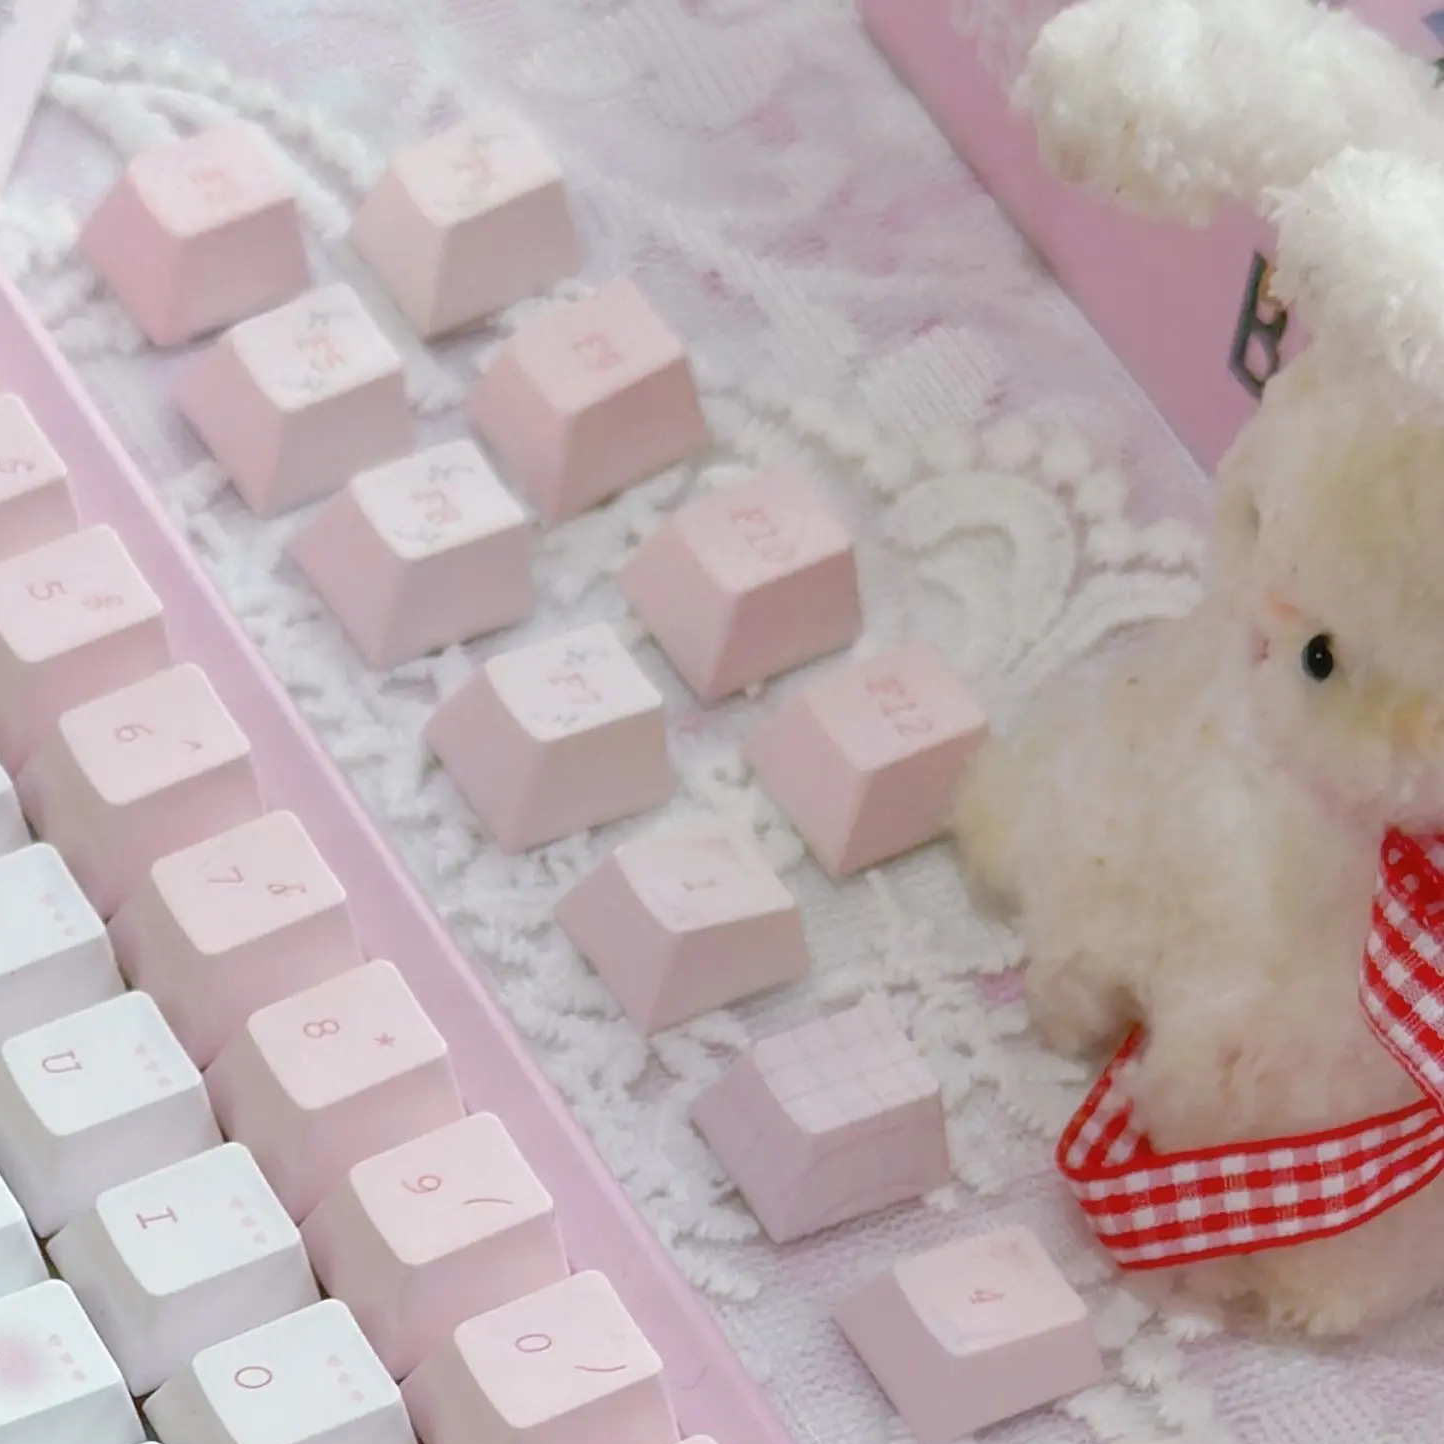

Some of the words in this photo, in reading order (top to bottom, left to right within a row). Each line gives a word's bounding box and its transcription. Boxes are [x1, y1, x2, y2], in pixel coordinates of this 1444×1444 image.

[27, 581, 68, 601] 5
[114, 724, 153, 744] 6
[207, 866, 244, 886] 7
[303, 1019, 340, 1039] 8
[41, 1051, 82, 1074] U
[401, 1174, 443, 1194] 9
[136, 1206, 179, 1230] I
